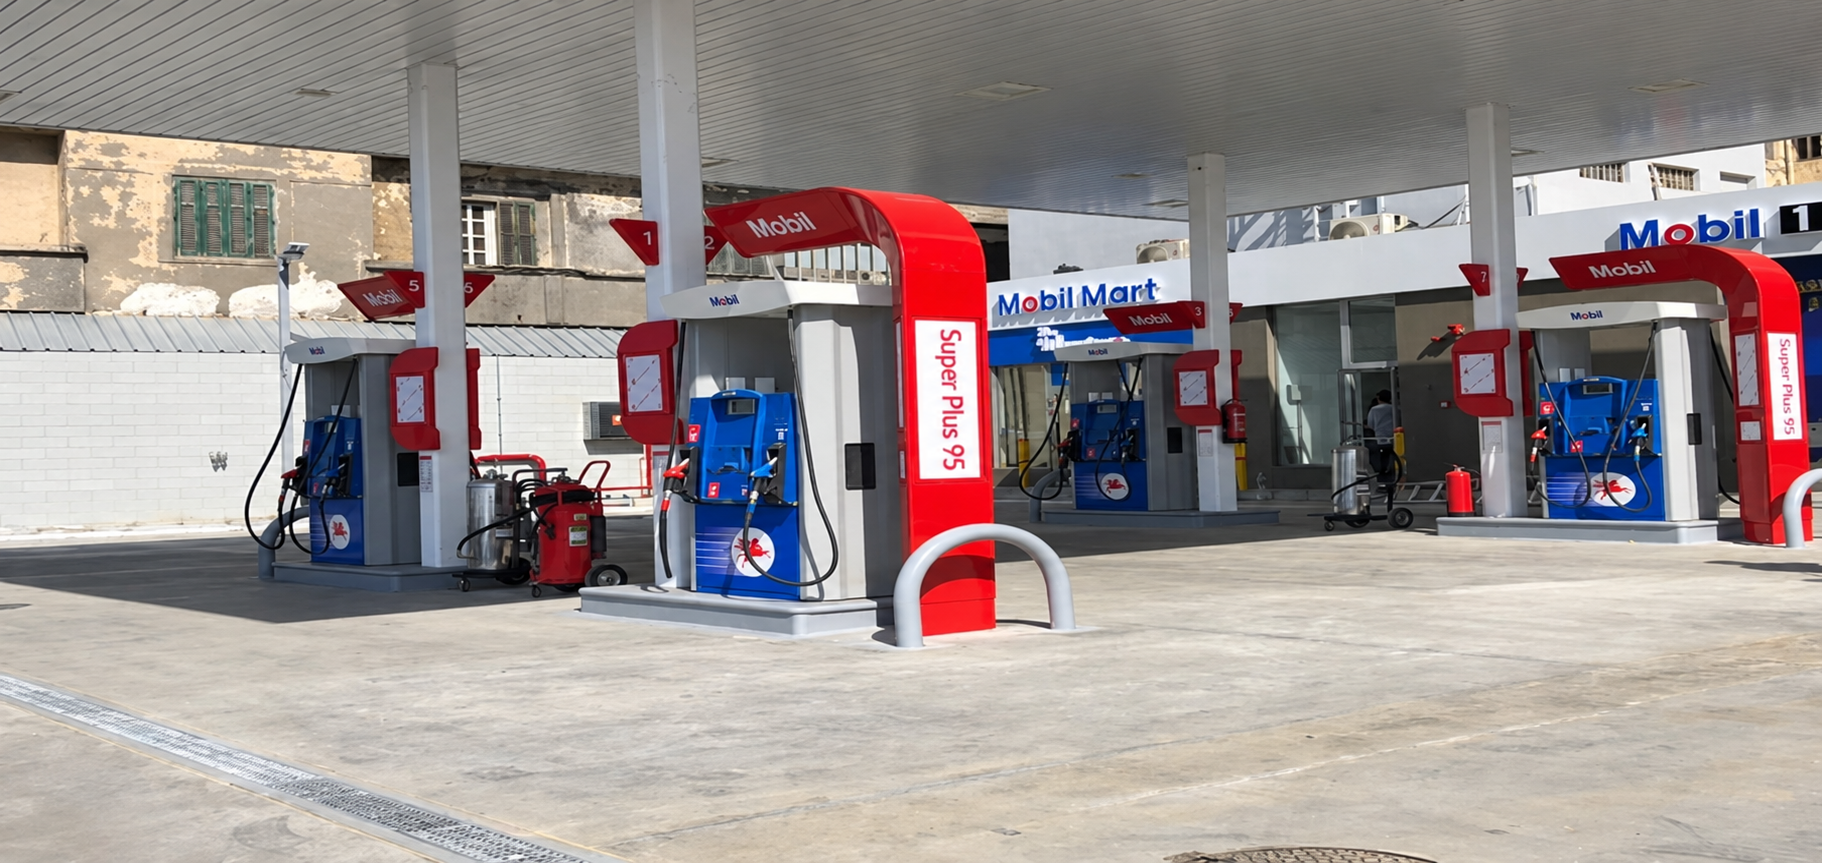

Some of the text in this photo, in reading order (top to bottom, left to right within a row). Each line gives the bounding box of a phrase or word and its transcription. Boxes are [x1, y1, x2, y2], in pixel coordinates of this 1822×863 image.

[745, 210, 817, 239] Mobil
[1619, 205, 1809, 251] Mobil 1
[643, 231, 652, 246] 1
[704, 235, 715, 250] 2
[1587, 259, 1657, 279] Mobil
[408, 279, 420, 292] 5
[463, 282, 474, 293] 6
[362, 288, 403, 307] Mobil
[709, 294, 740, 307] Mobil
[998, 278, 1157, 316] Mobil Mart
[1194, 306, 1202, 316] 3
[1569, 309, 1603, 321] Mobil
[1128, 312, 1173, 327] Mobil
[1087, 348, 1109, 356] Mobil
[1777, 338, 1796, 435] Super Plus 95
[935, 328, 966, 471] Super Plus 95
